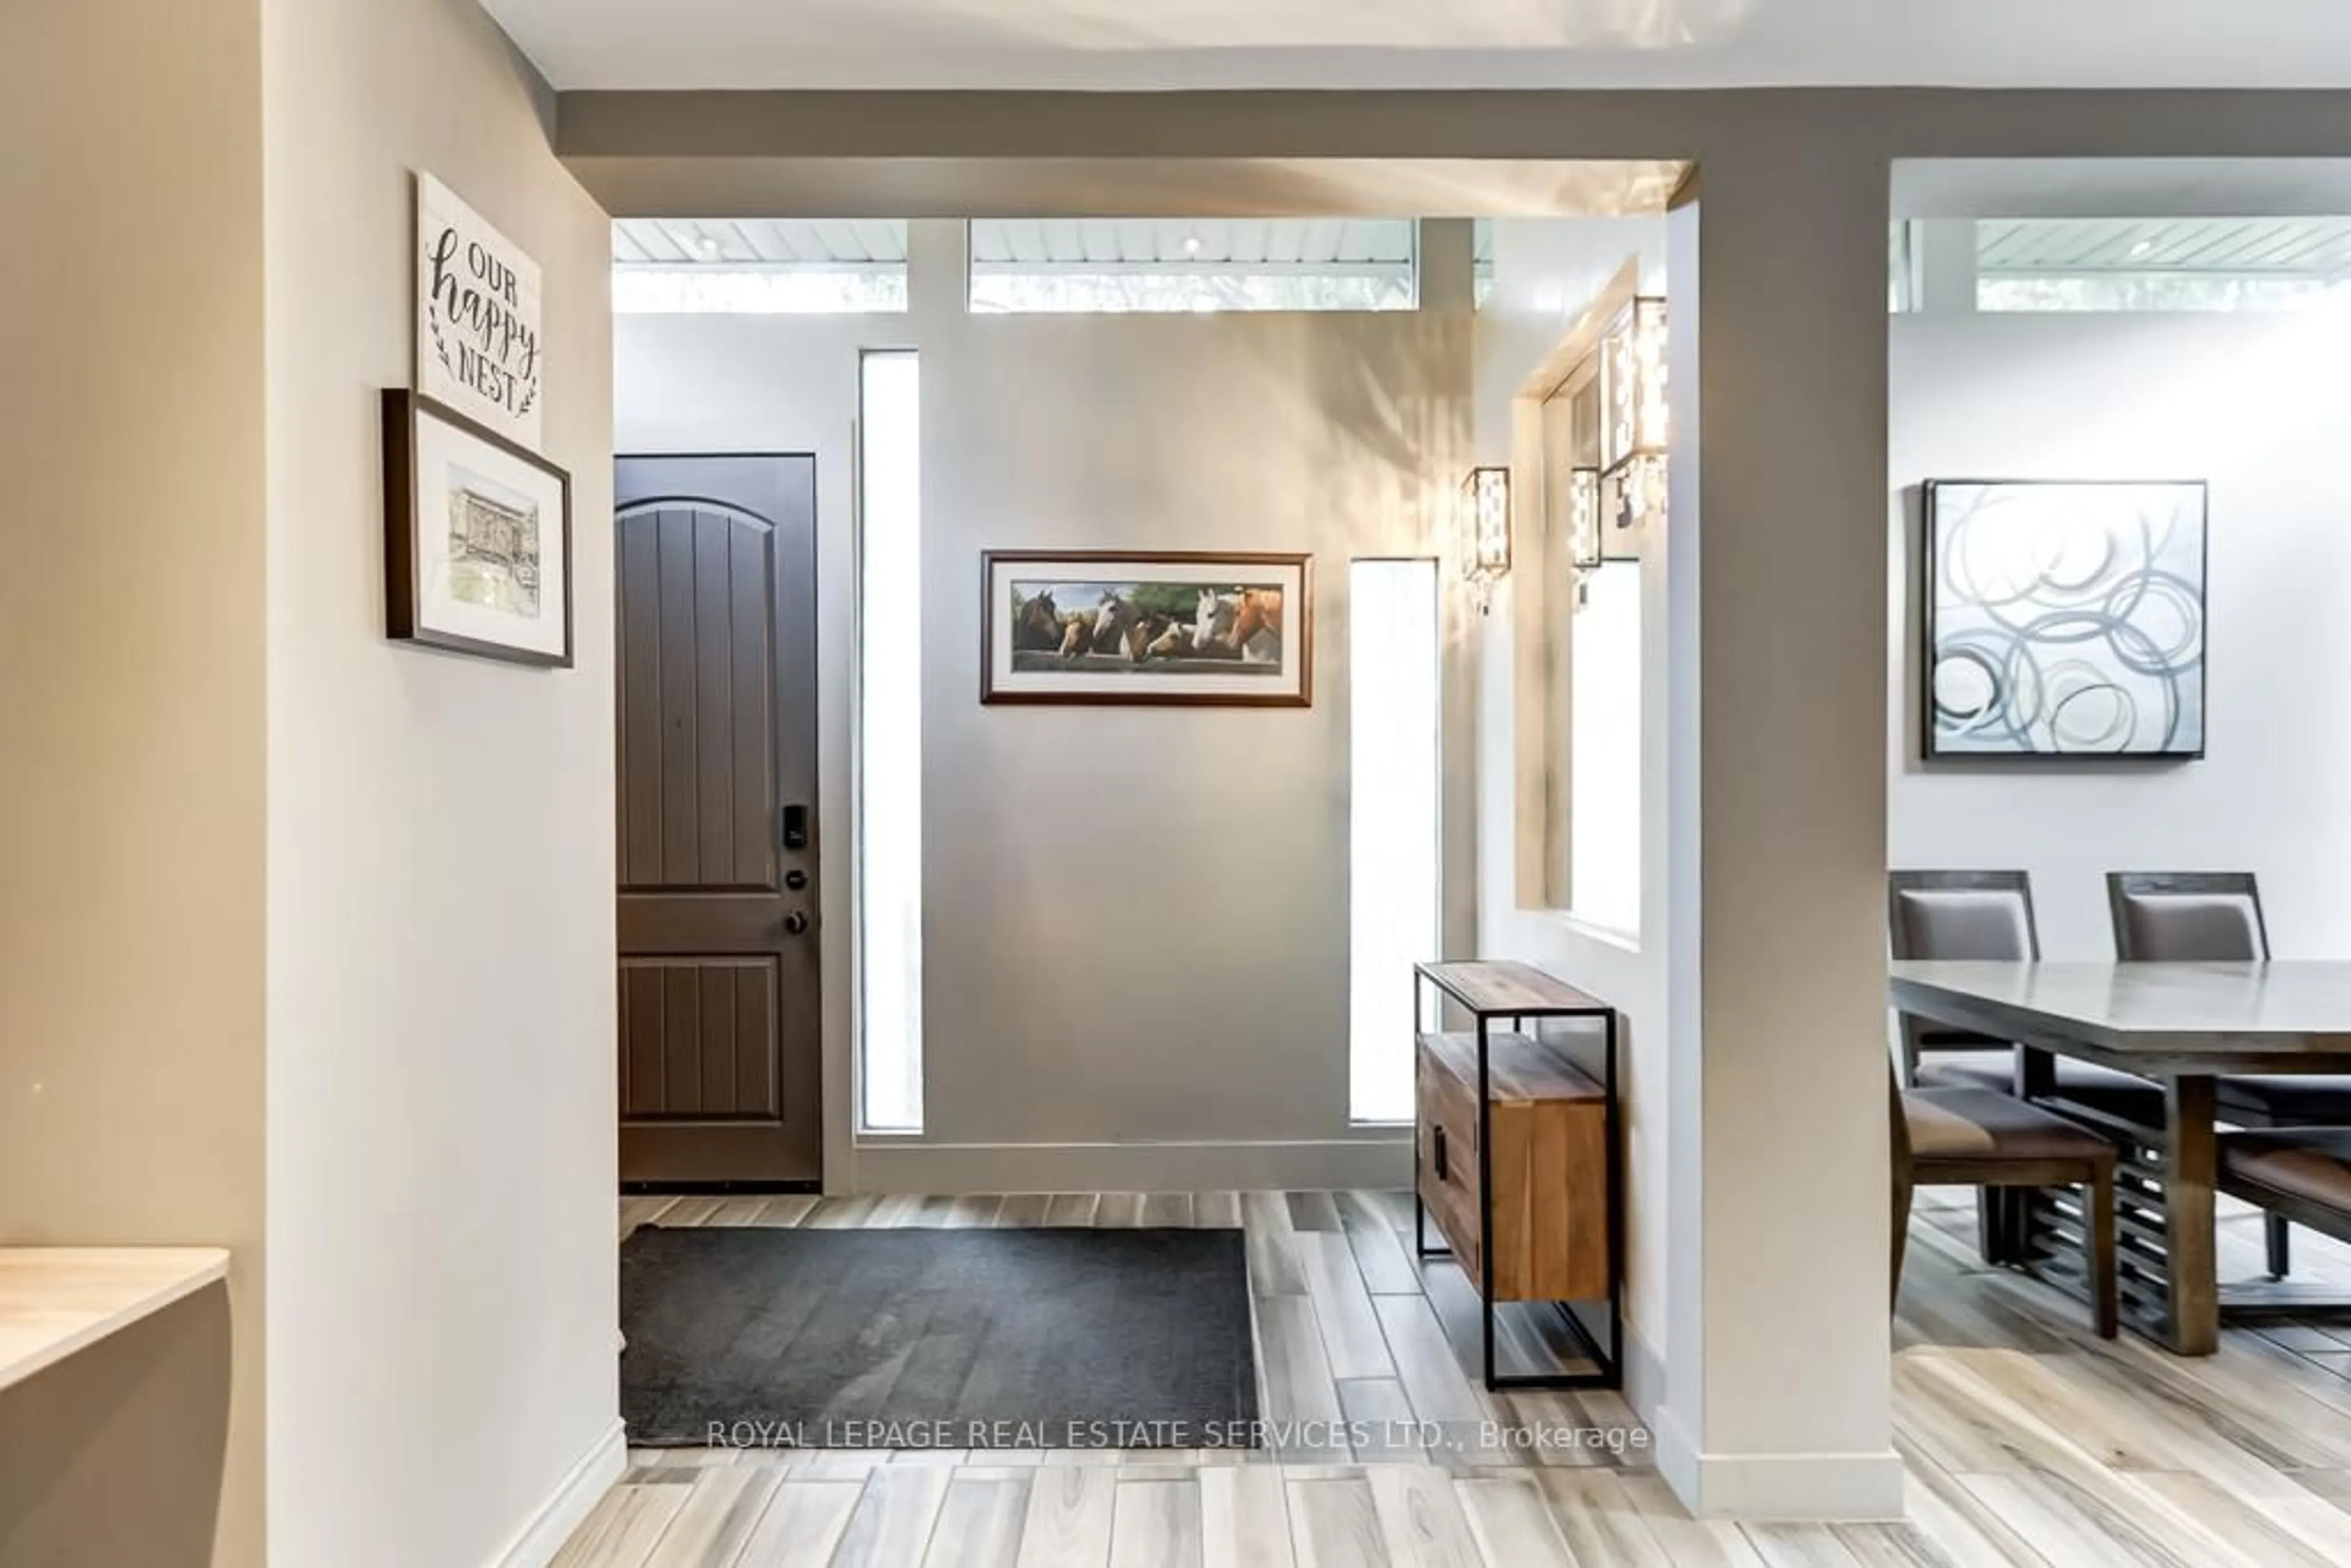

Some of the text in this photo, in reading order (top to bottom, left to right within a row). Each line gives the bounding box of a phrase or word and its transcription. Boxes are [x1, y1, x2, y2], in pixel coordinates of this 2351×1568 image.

[426, 227, 541, 380] happy
[468, 242, 517, 308] OUR
[459, 339, 516, 411] NEST
